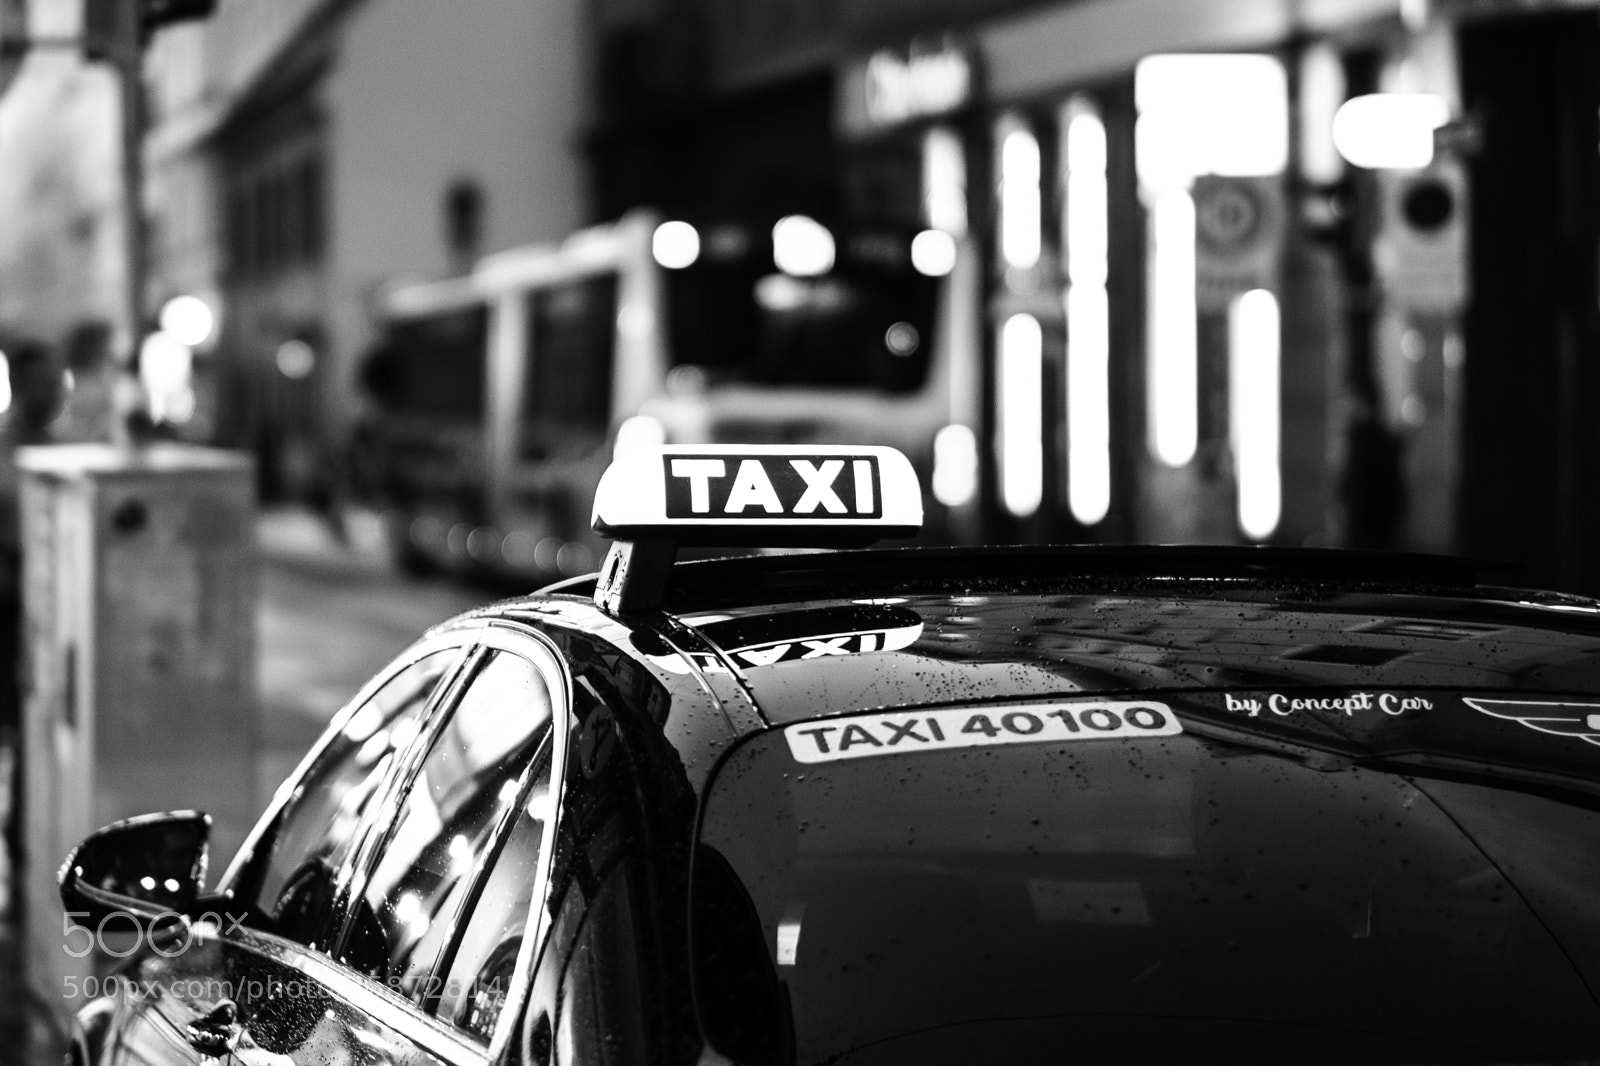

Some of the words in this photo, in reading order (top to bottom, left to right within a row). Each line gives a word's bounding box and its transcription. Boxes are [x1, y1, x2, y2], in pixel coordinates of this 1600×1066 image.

[670, 458, 875, 514] TAXI
[1225, 693, 1261, 717] by
[1268, 692, 1374, 716] Concept
[1378, 693, 1434, 716] Car
[797, 717, 946, 754] TAXI
[960, 706, 1168, 738] 40100
